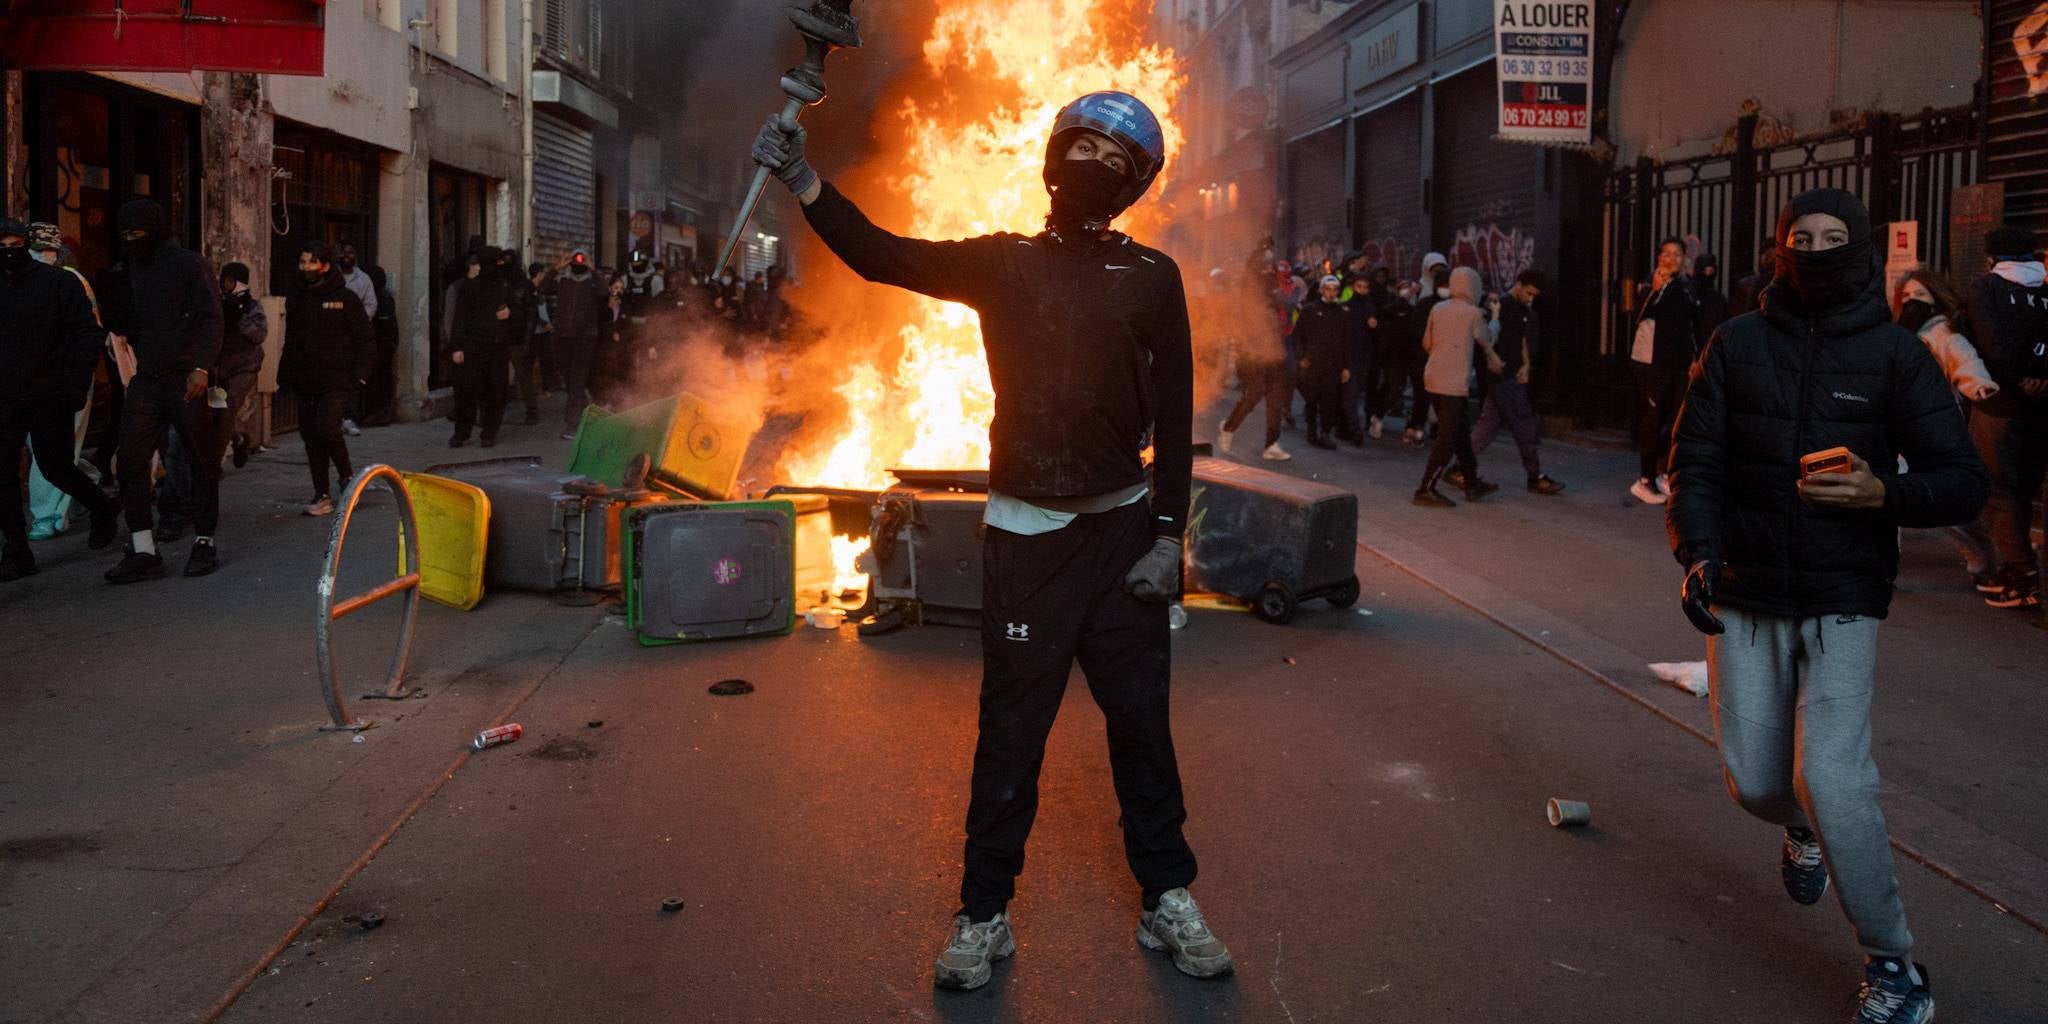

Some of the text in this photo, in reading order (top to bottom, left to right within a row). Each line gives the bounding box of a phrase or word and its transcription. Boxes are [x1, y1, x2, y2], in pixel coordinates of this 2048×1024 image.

[1522, 4, 1588, 27] LOUER
[1503, 60, 1587, 76] 06 30 32 19 35
[1540, 86, 1561, 100] JLL
[1504, 108, 1586, 126] 06 70 24 99 12
